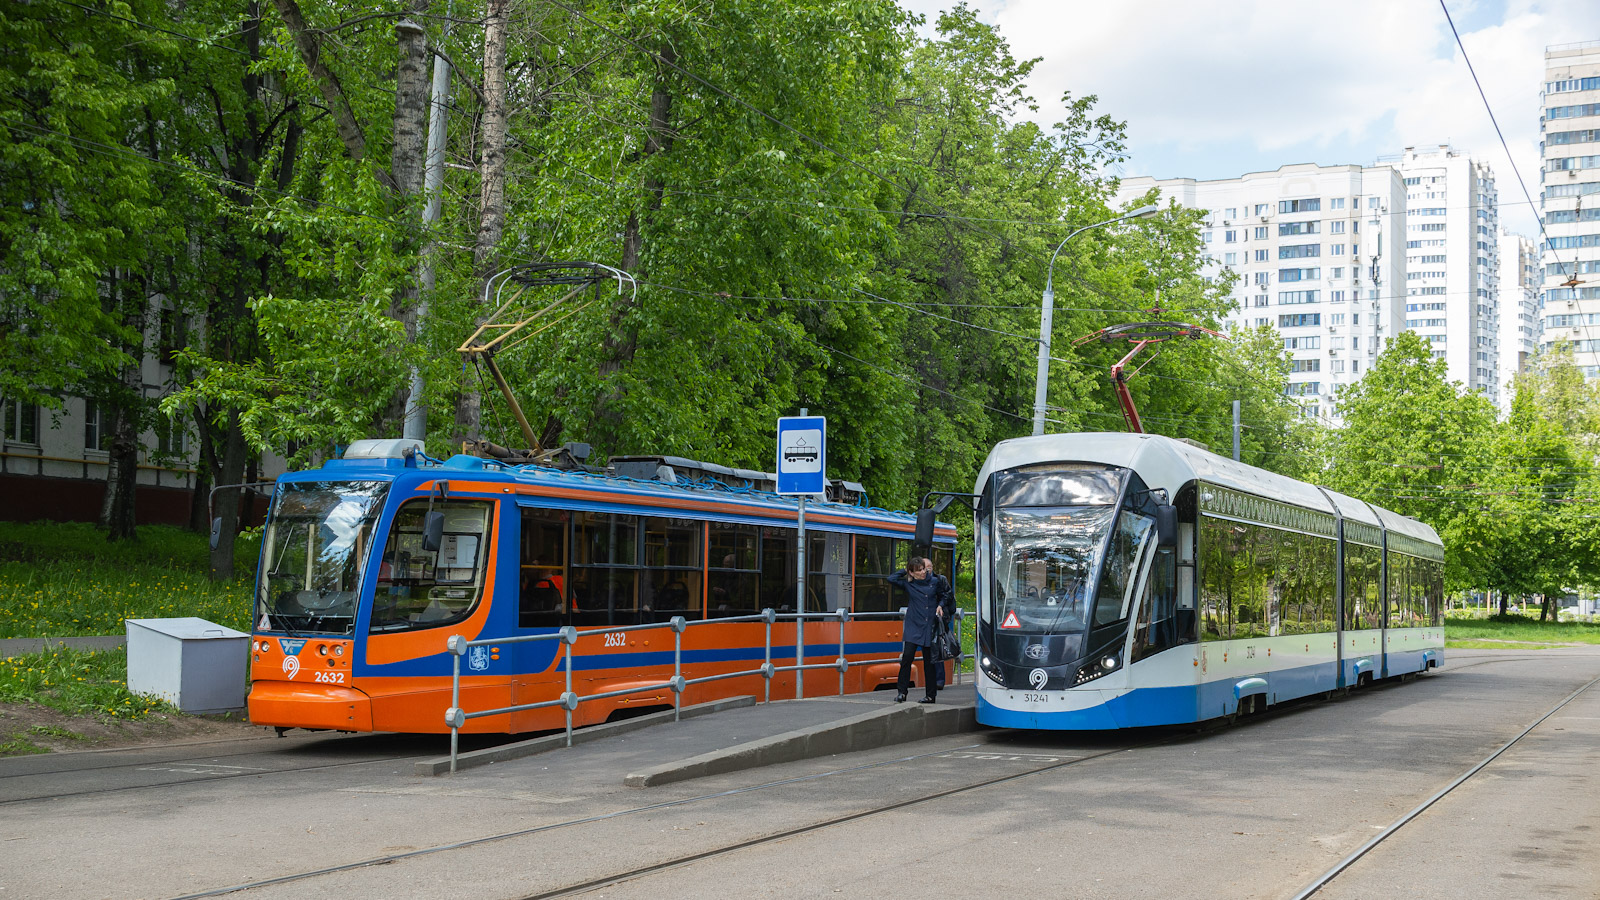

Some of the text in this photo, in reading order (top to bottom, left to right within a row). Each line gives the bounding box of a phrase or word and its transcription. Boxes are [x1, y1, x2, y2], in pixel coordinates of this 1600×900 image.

[604, 632, 626, 647] 2632
[314, 671, 345, 683] 2632
[1024, 693, 1049, 703] 31241
